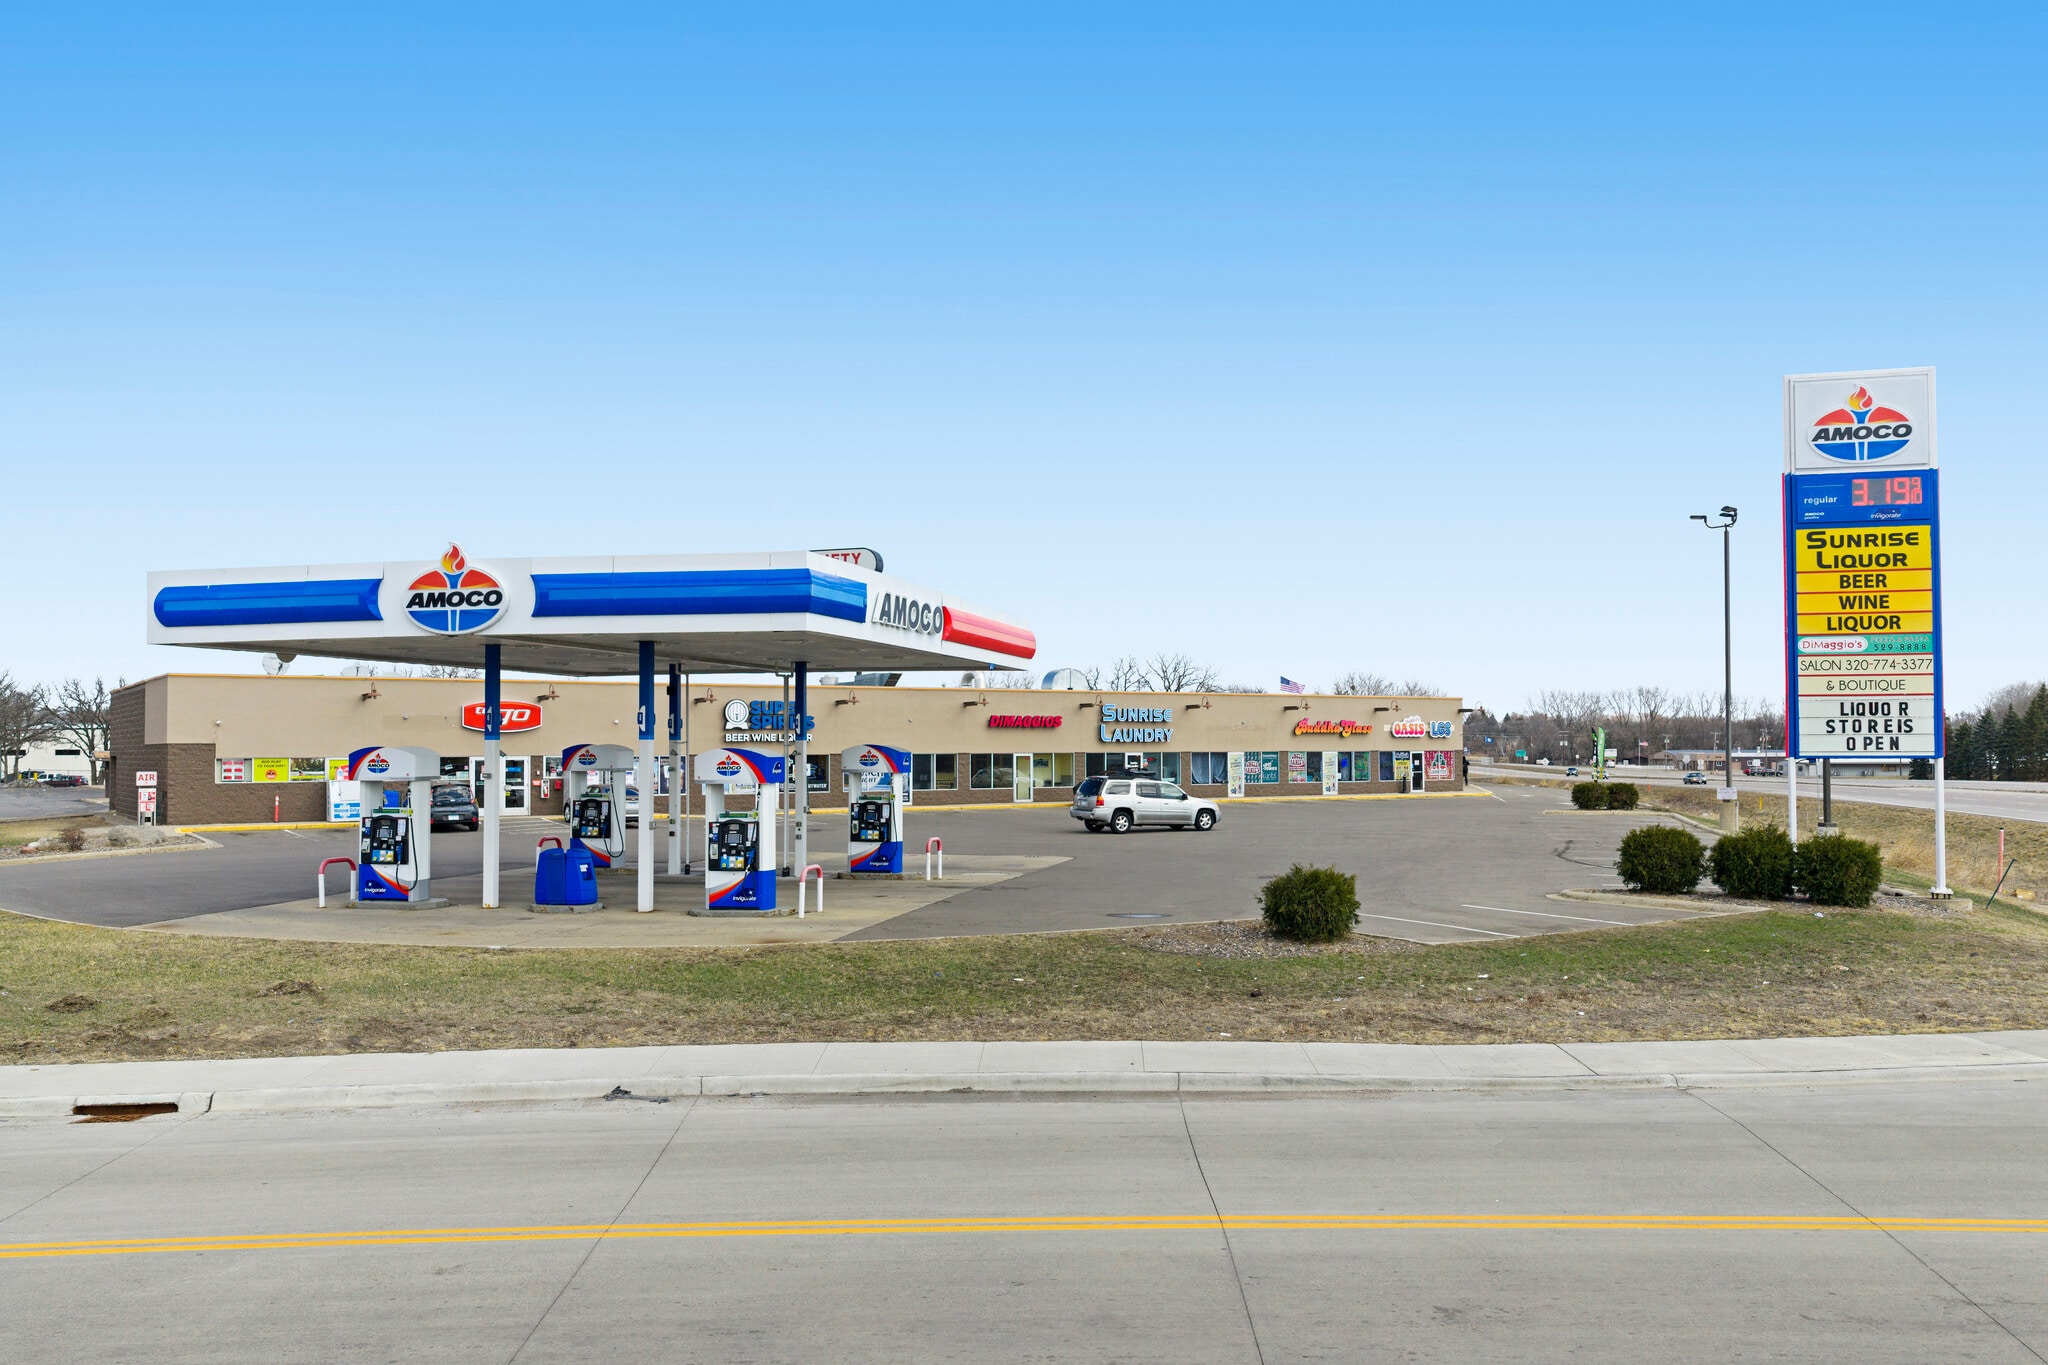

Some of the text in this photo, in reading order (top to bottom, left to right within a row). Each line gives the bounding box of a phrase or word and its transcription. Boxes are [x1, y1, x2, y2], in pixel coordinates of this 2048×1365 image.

[1811, 423, 1913, 442] AMOCO
[1852, 477, 1910, 506] 3.19
[1804, 495, 1838, 506] regular
[1806, 531, 1919, 549] SUNRISE
[1816, 551, 1908, 568] LIQUOR
[1839, 574, 1887, 589] BEER
[405, 589, 503, 608] AMOCO
[1839, 595, 1890, 610] WINE
[879, 592, 943, 634] AMOCO
[1827, 615, 1901, 632] LIQUOR
[1802, 640, 1863, 651] DiMaggio's
[1800, 658, 1933, 671] SALON 320-774-3377
[1826, 679, 1906, 691] & BOUTIQUE
[750, 701, 796, 715] SUPE
[1102, 704, 1173, 723] SUNRISE
[1101, 724, 1174, 743] LAUNDRY
[1295, 718, 1340, 735] Buddha
[1394, 723, 1424, 735] OASIS
[725, 733, 750, 742] BEER
[751, 733, 777, 742] WINE
[1846, 736, 1900, 751] OPEN
[138, 773, 155, 781] AIR
